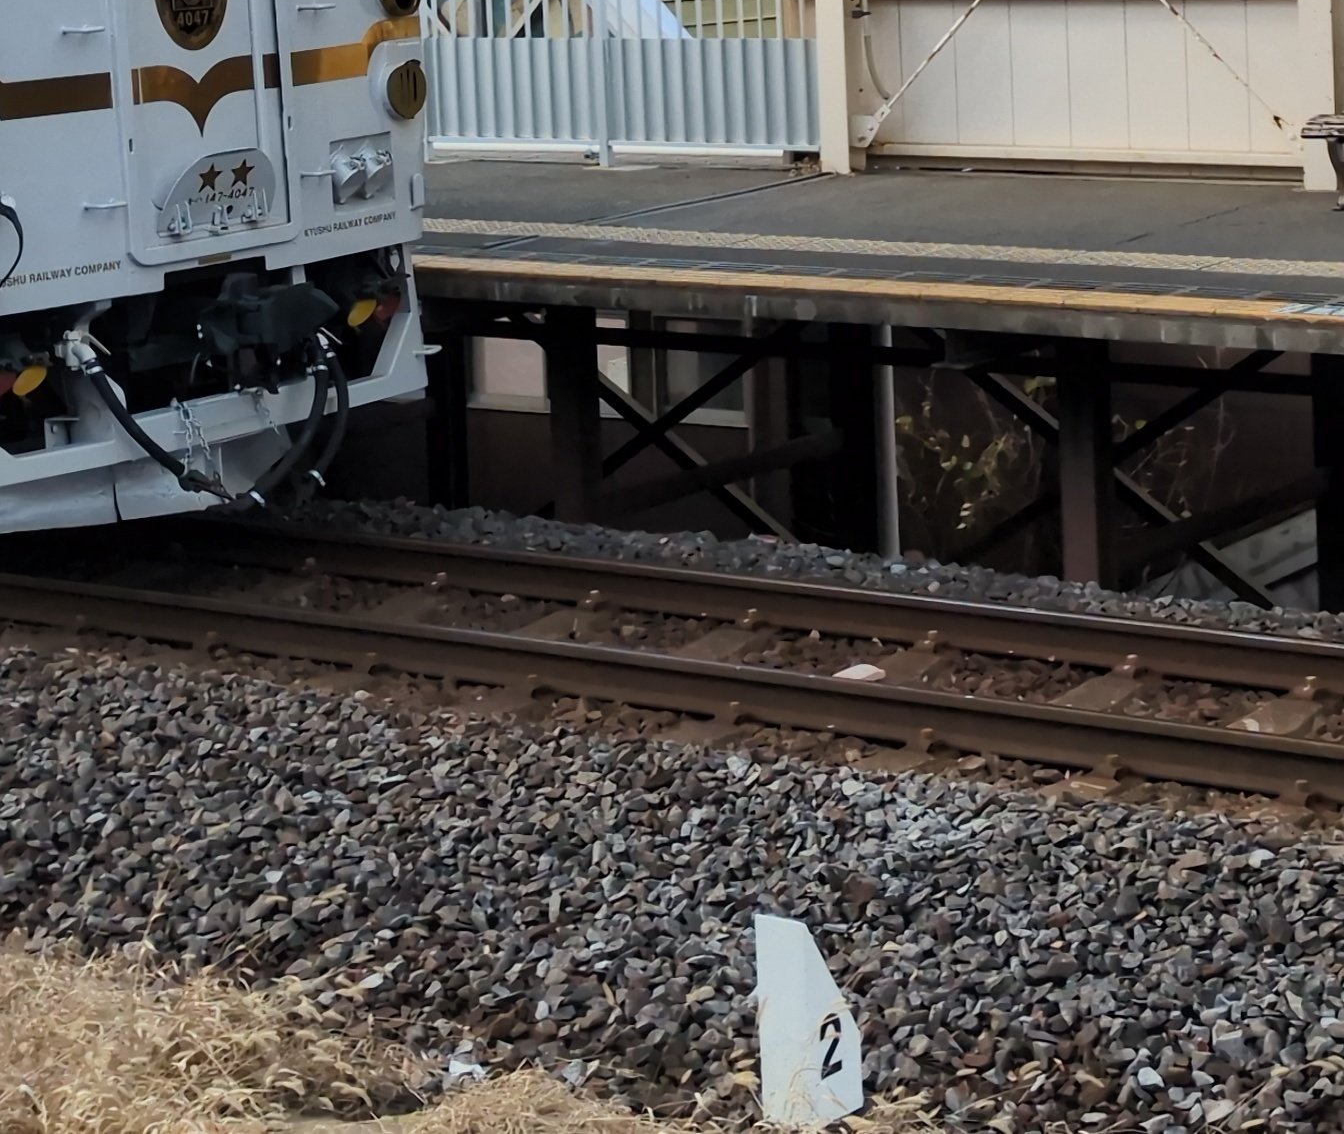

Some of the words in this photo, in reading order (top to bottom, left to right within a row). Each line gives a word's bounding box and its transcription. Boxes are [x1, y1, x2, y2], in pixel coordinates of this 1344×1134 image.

[177, 9, 210, 26] 4047
[29, 267, 72, 284] RAILWAY
[74, 260, 122, 276] COMPANY
[819, 1012, 843, 1080] 2
